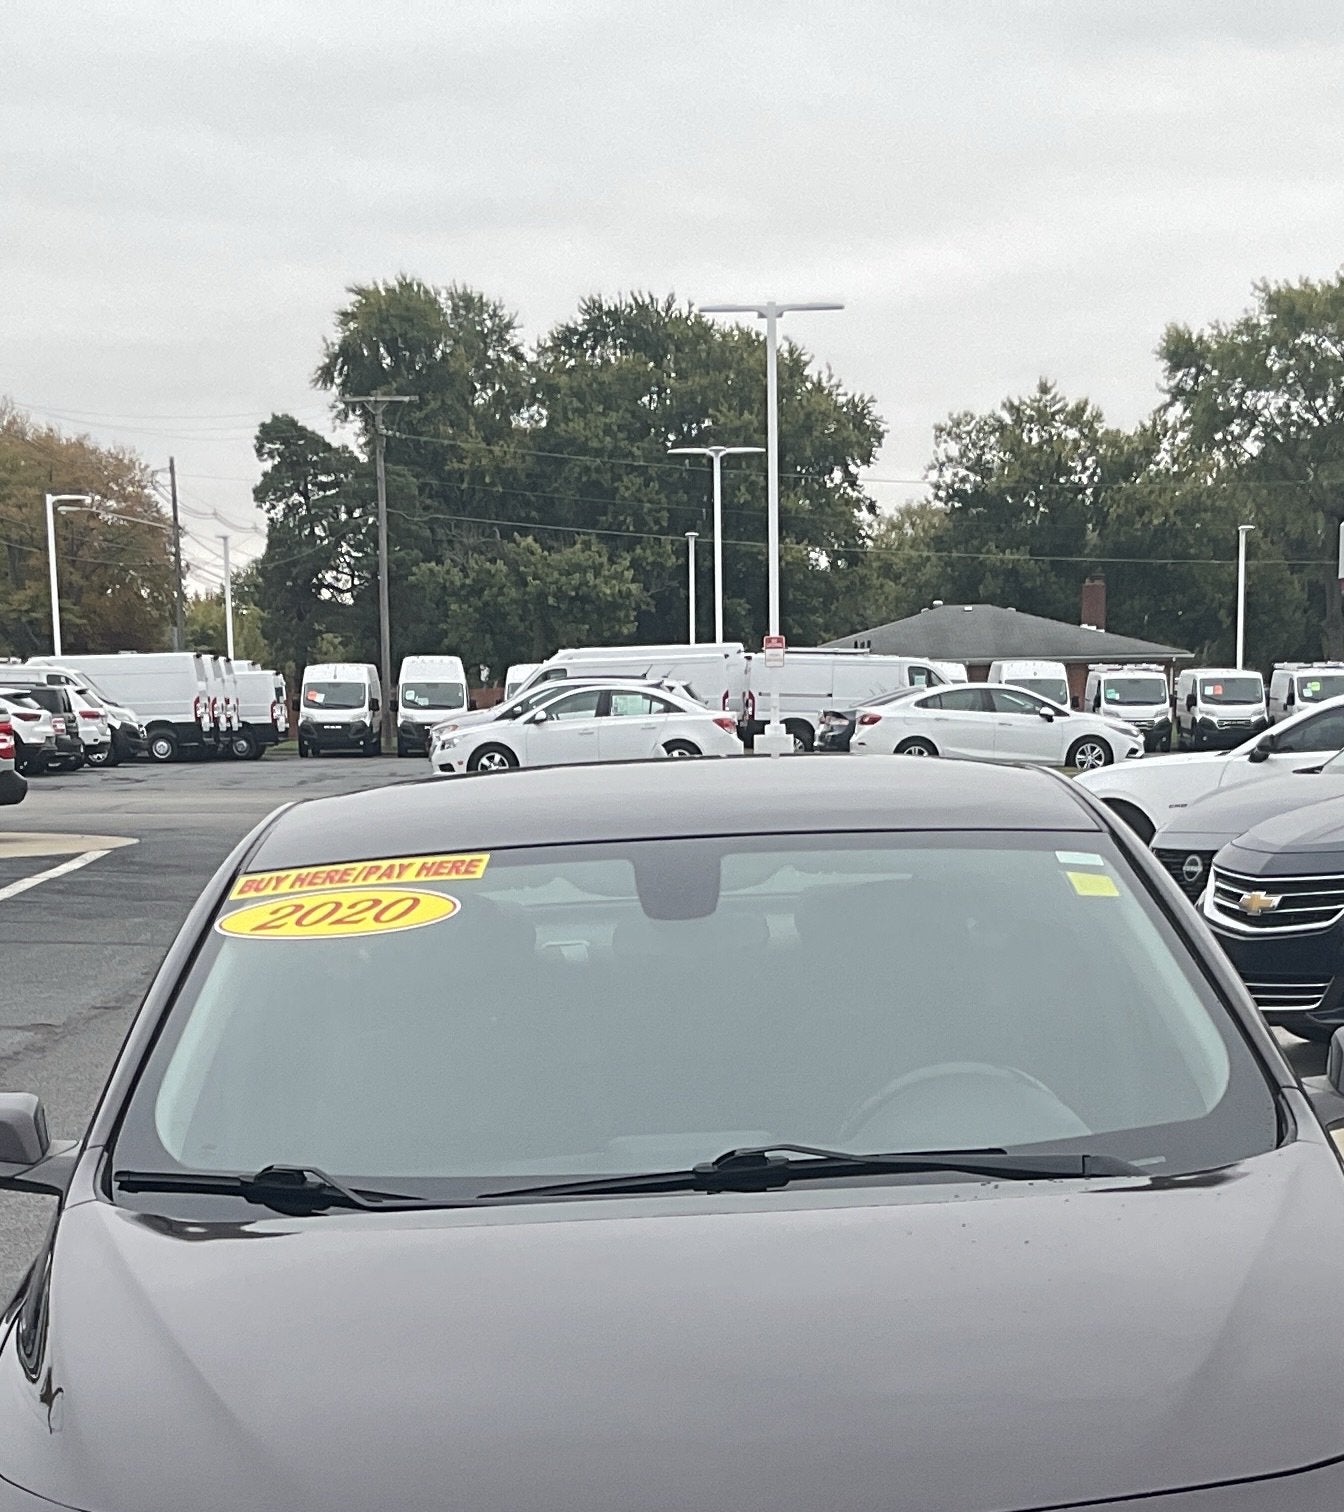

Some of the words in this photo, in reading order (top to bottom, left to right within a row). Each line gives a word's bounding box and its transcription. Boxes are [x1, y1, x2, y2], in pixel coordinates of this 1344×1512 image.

[237, 875, 289, 895] BUY
[290, 862, 412, 887] HERE/PAY
[415, 859, 484, 877] HERE
[251, 897, 421, 931] 2020
